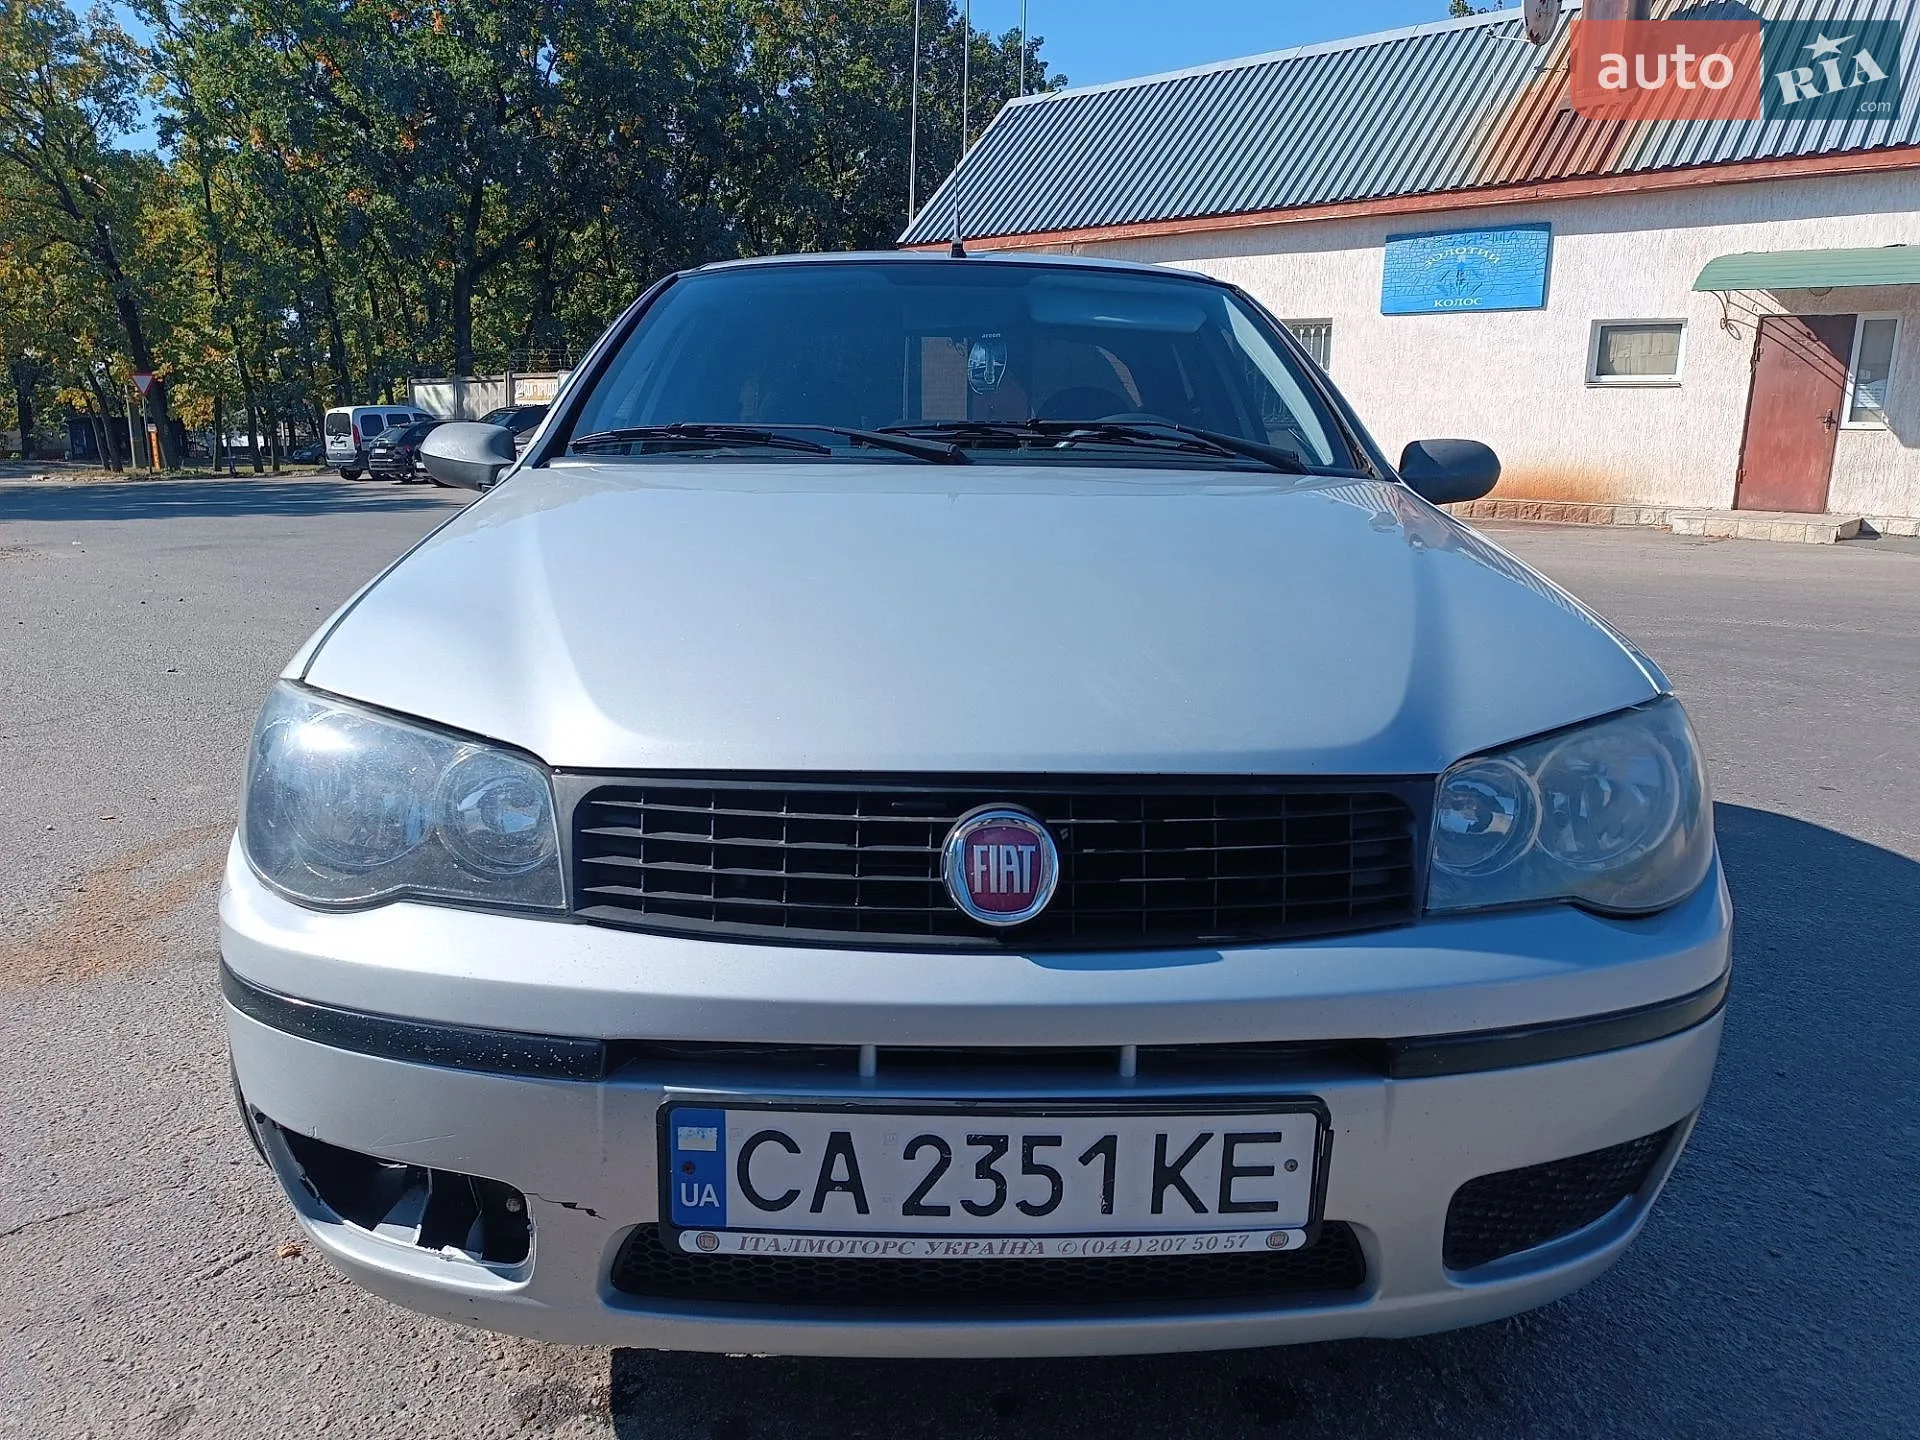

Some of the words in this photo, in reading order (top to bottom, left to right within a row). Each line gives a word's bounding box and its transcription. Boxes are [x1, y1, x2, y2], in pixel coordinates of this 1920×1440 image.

[1432, 296, 1484, 308] КОЛОС
[972, 843, 1036, 894] FIAT
[736, 1129, 870, 1214] CA
[902, 1134, 1118, 1217] 2351
[1151, 1131, 1283, 1215] KE
[680, 1182, 720, 1207] UA
[924, 1236, 1045, 1256] УКРАЇНА
